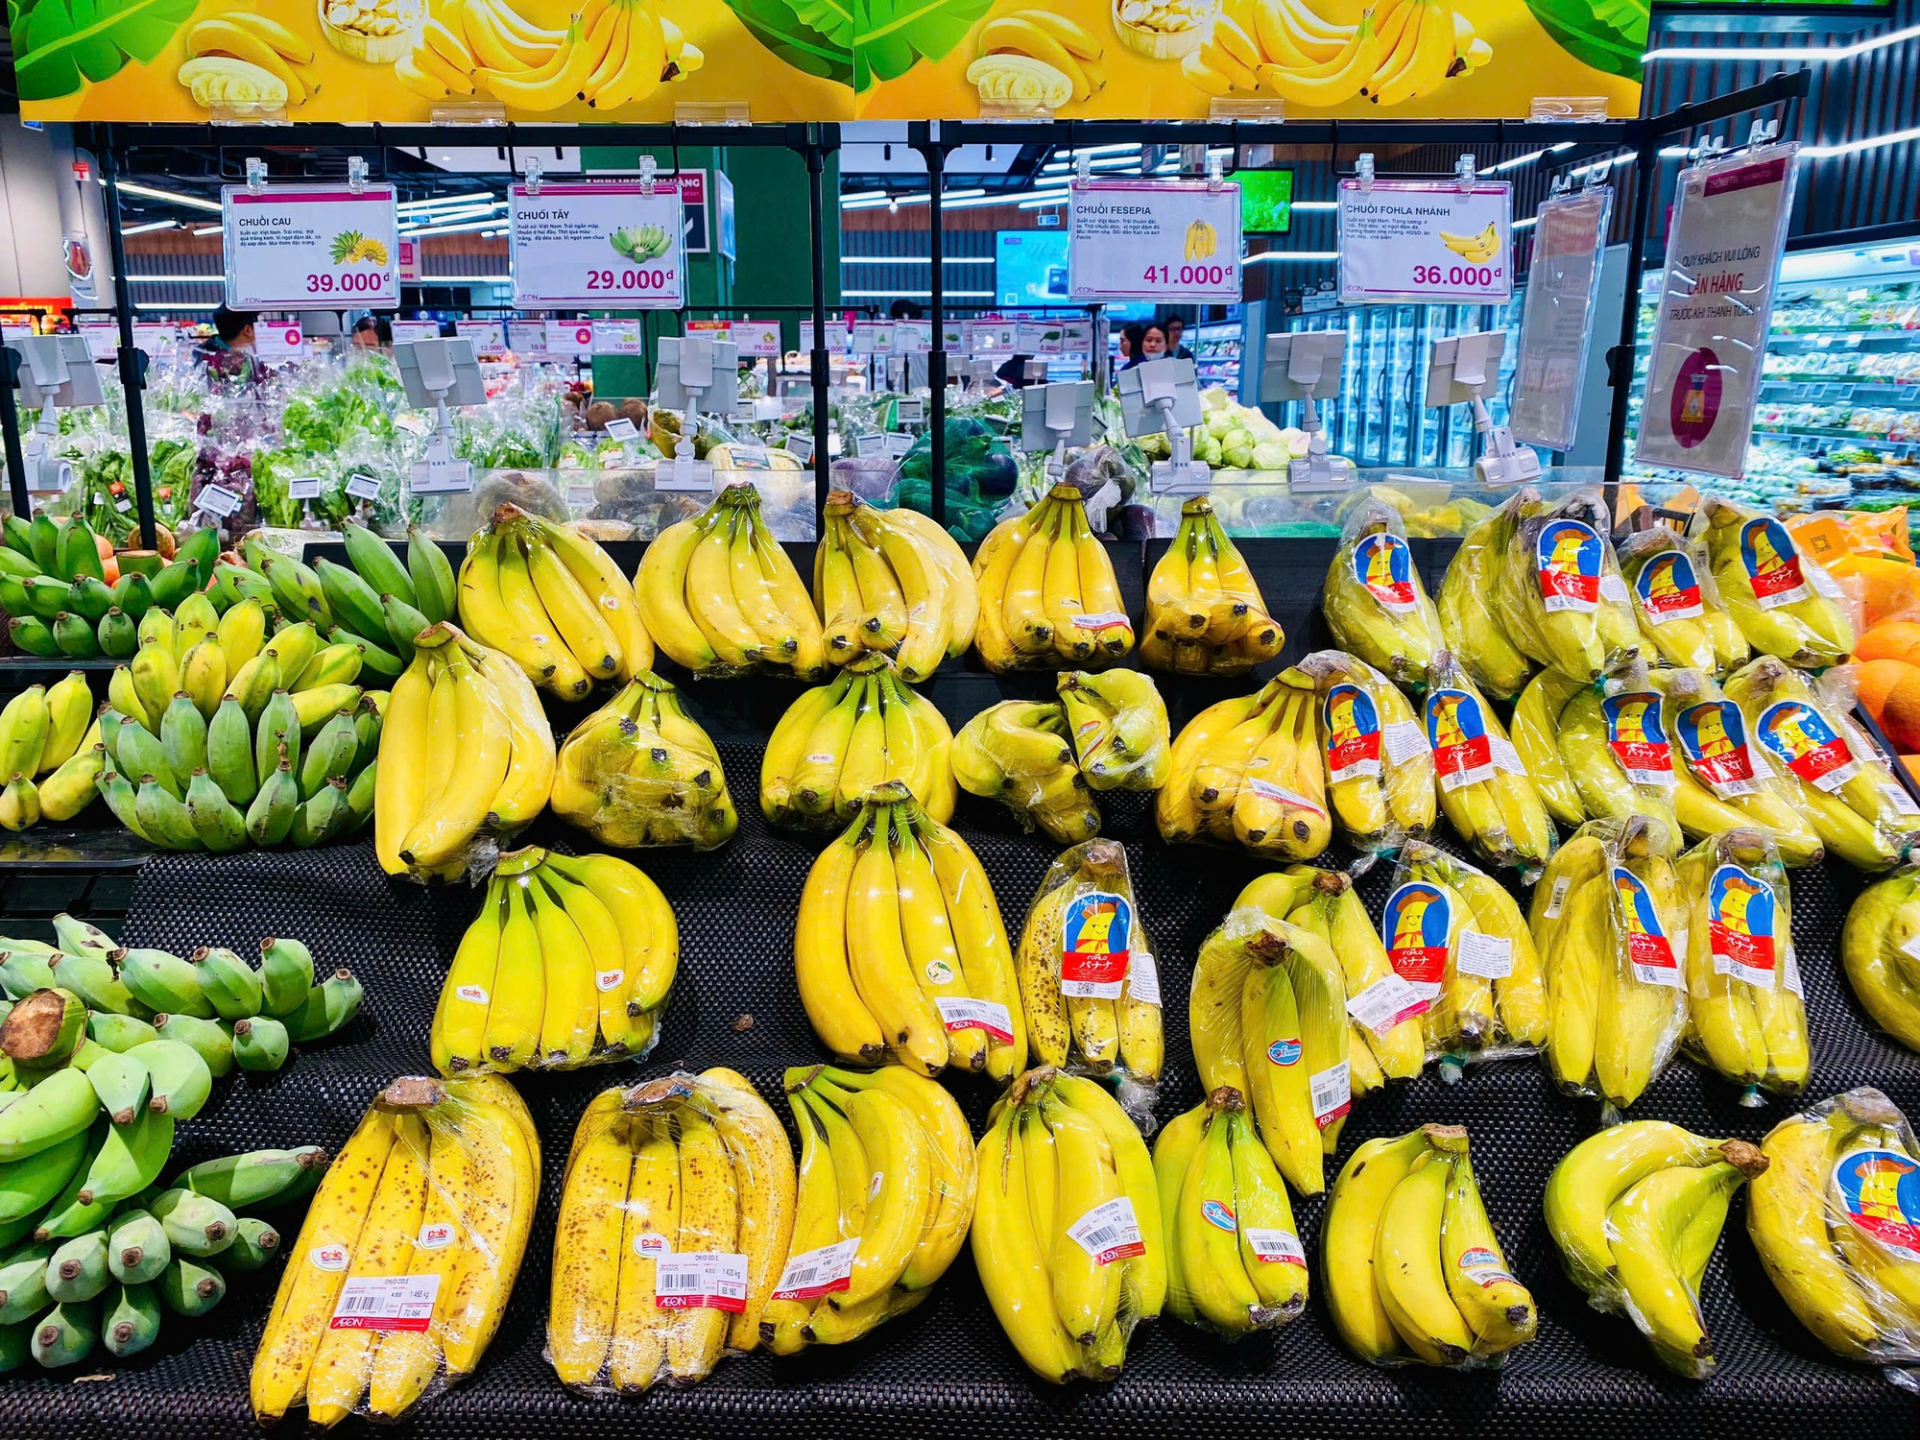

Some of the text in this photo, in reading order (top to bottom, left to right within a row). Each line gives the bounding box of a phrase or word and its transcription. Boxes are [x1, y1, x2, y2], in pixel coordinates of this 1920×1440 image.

[552, 209, 569, 219] TÂY
[1111, 206, 1151, 214] FESEPIA
[1380, 206, 1412, 215] FOHLA
[272, 218, 291, 226] CAU
[1707, 306, 1732, 318] THANH
[1080, 961, 1113, 970] バナナ
[1397, 956, 1429, 966] バナナ
[428, 1228, 447, 1239] Dole
[321, 1250, 342, 1260] Dole
